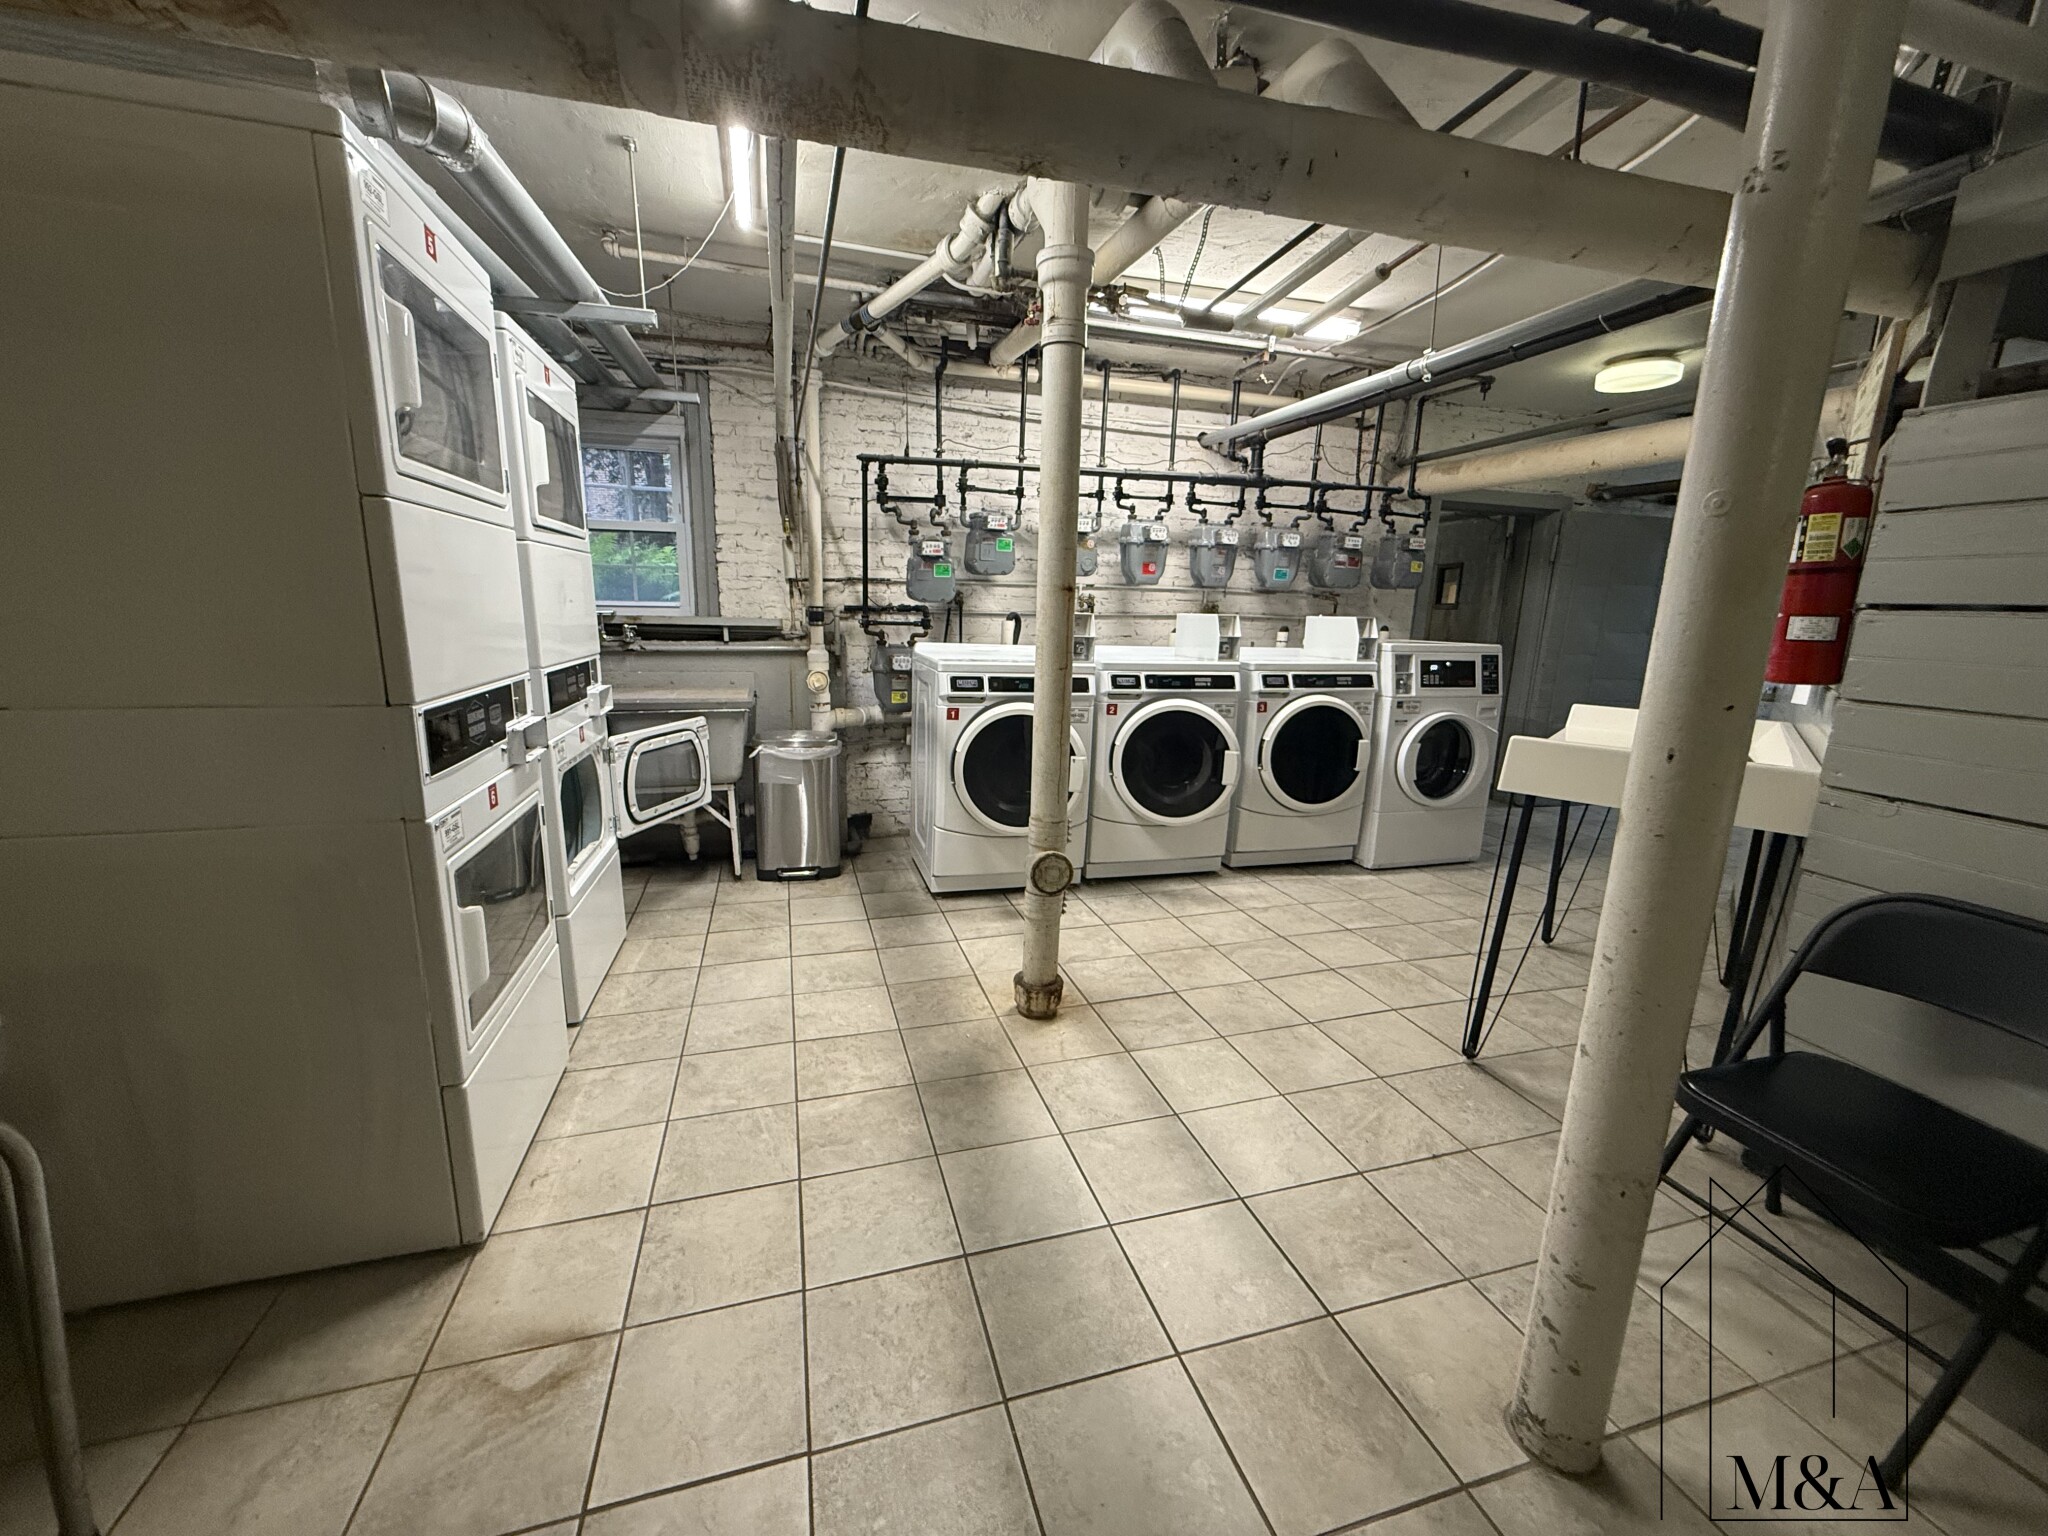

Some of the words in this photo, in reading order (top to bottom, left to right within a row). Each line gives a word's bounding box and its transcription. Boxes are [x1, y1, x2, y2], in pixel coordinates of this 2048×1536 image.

[427, 236, 434, 255] 5
[1109, 707, 1115, 715] 2
[1259, 703, 1265, 712] 3
[950, 710, 956, 719] 1
[490, 790, 496, 805] 6
